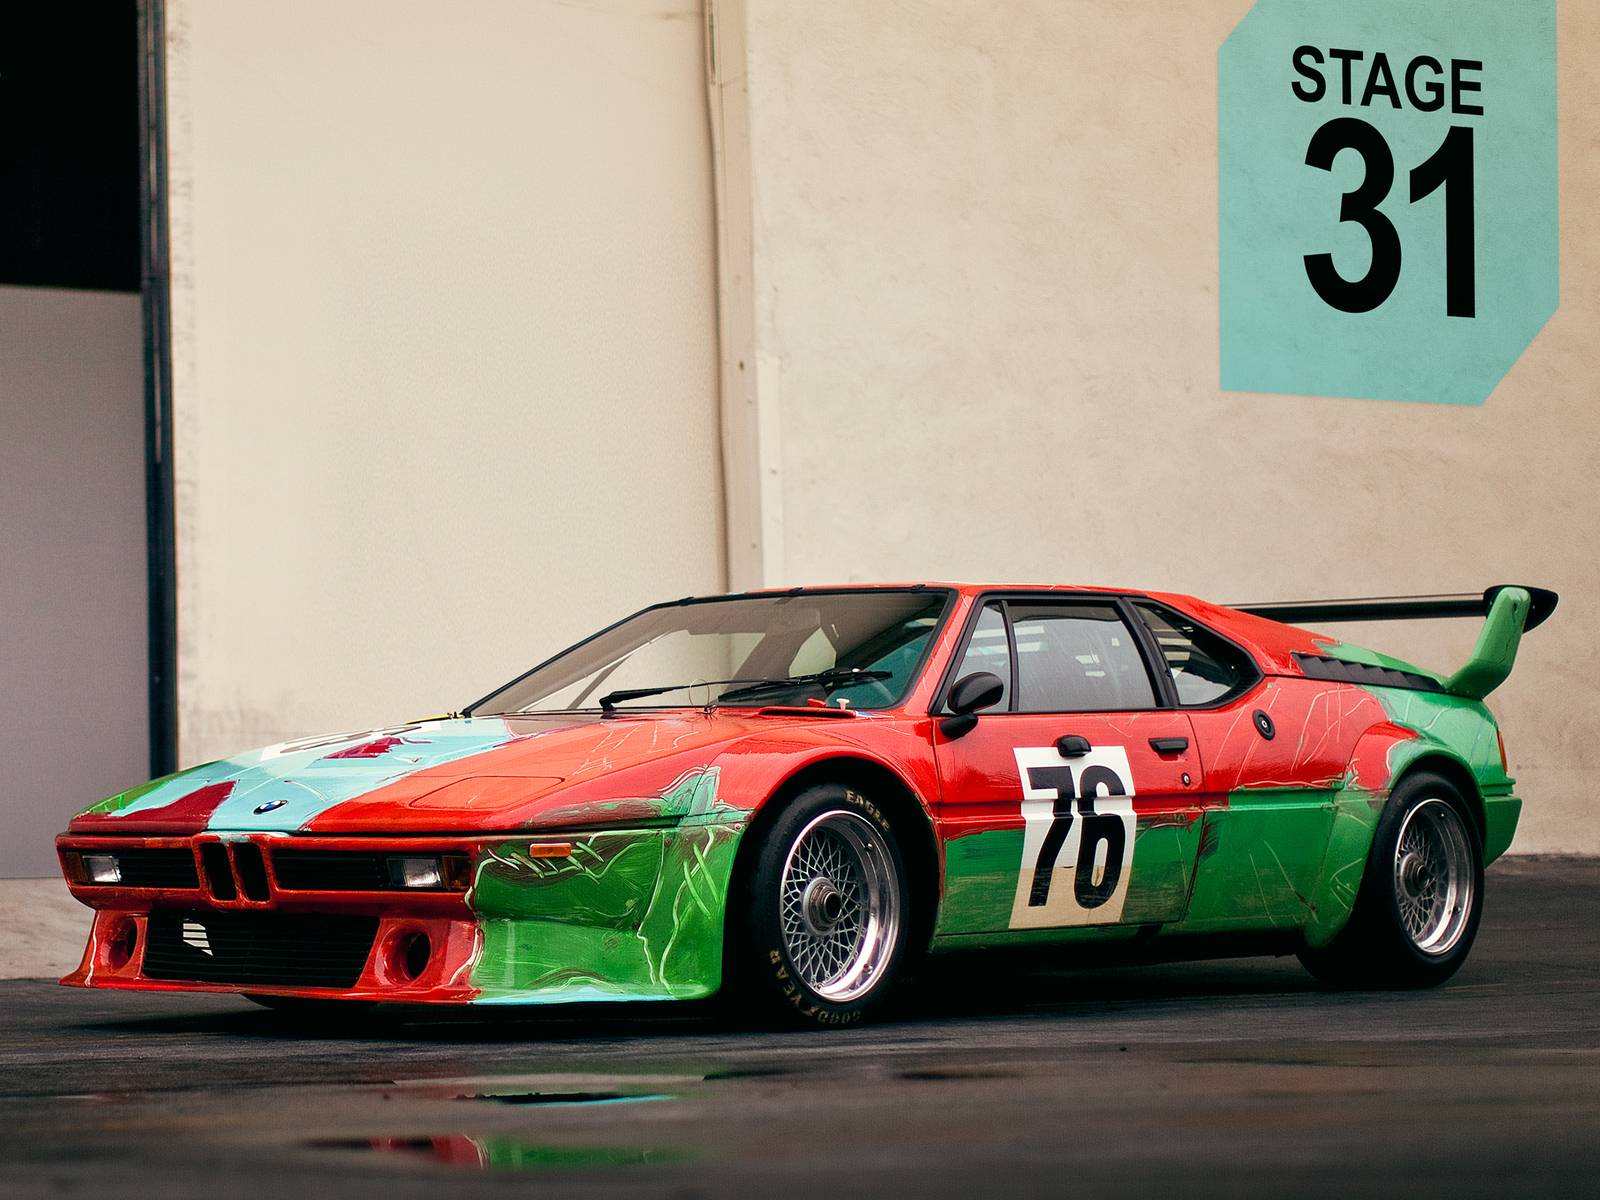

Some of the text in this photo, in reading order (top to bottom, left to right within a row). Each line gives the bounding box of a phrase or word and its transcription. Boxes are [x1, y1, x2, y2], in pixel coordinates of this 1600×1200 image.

[1291, 45, 1484, 116] STAGE
[1303, 117, 1476, 319] 31
[845, 789, 890, 832] EAGLE
[1026, 765, 1126, 909] 76
